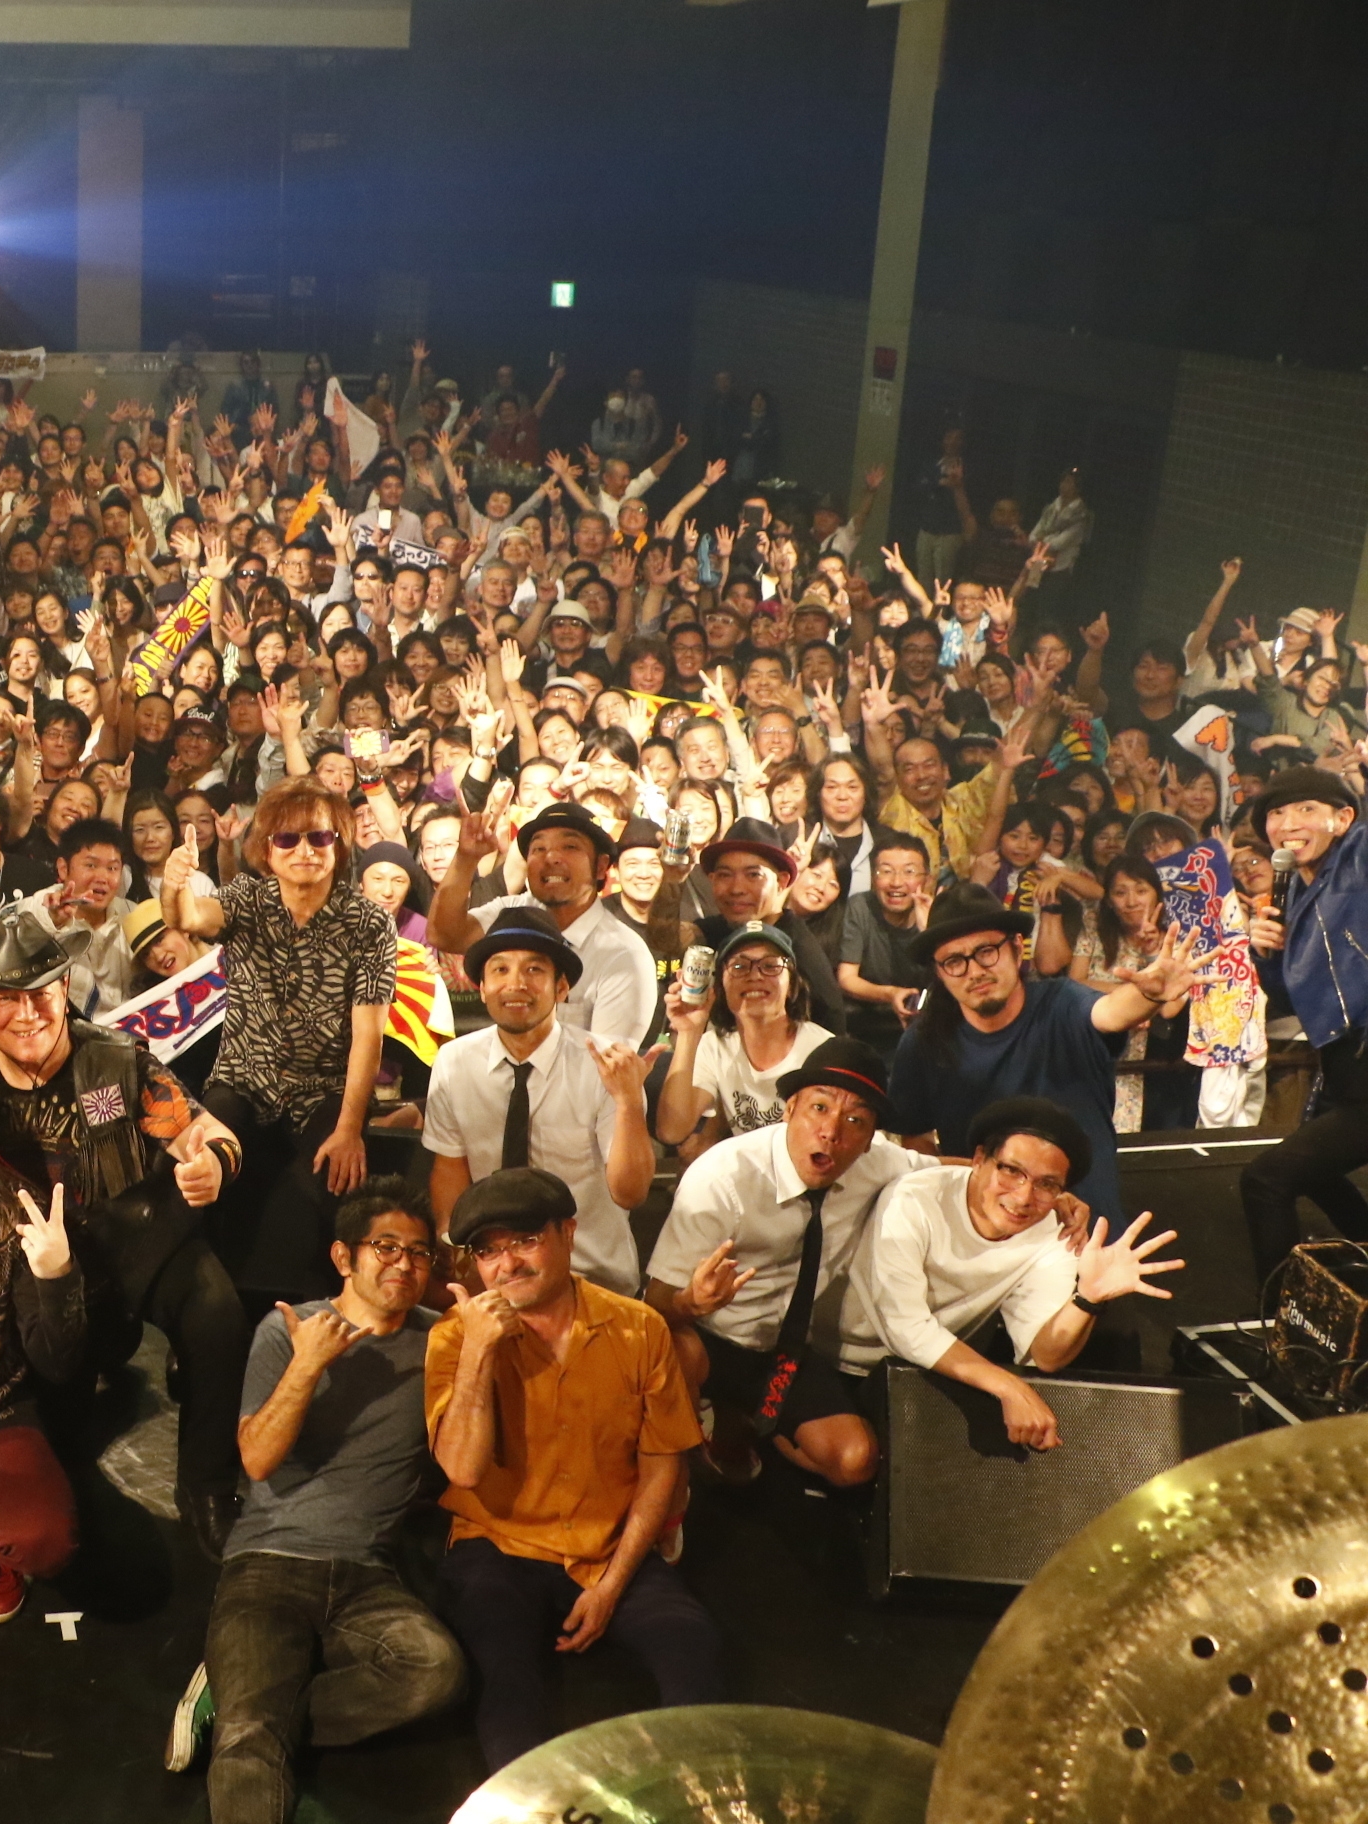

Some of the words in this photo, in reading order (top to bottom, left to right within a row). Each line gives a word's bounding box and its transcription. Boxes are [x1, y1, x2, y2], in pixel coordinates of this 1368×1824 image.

[746, 920, 764, 932] S
[686, 965, 711, 976] Orion
[1303, 1319, 1337, 1353] music
